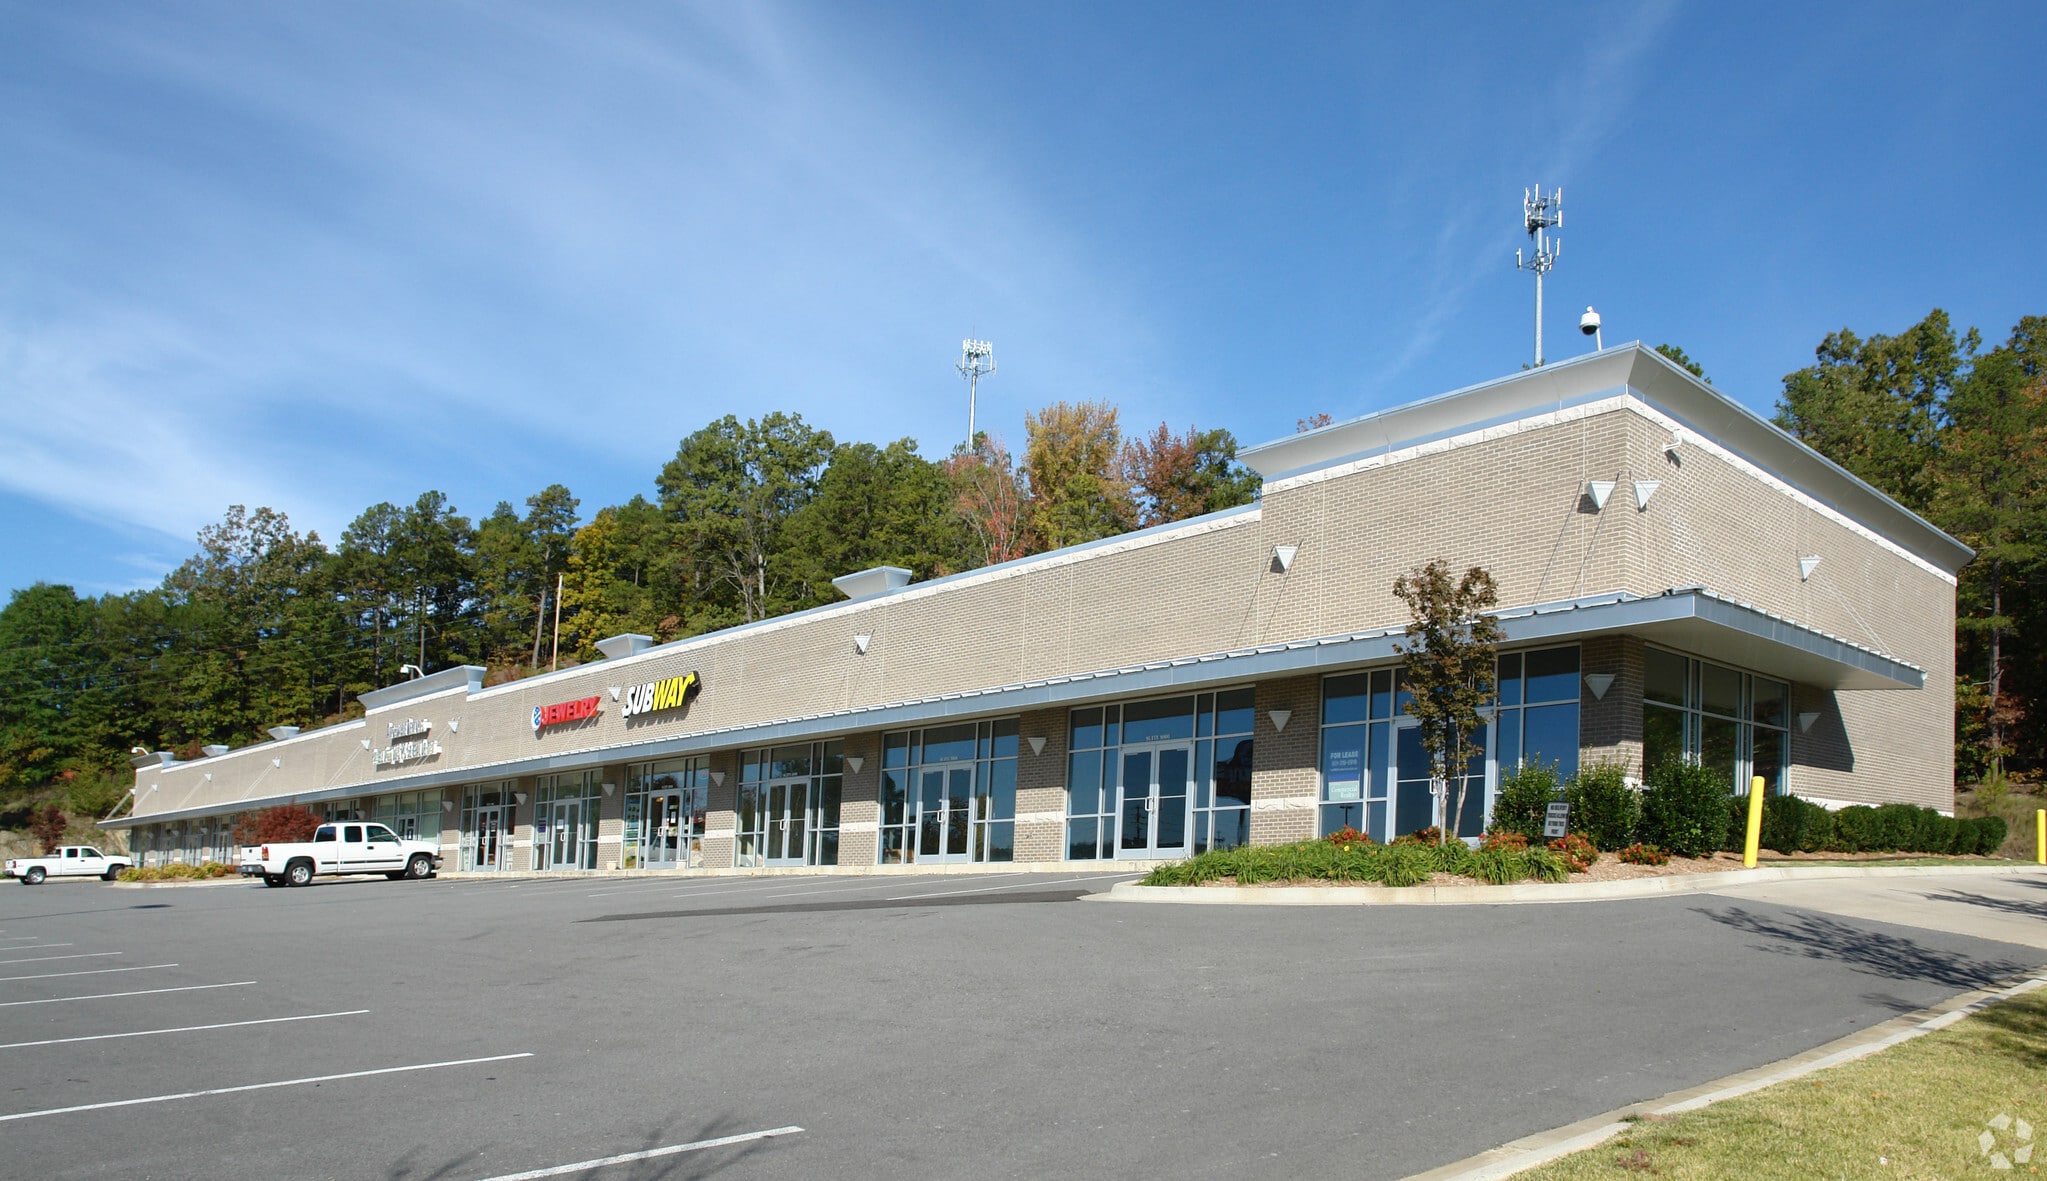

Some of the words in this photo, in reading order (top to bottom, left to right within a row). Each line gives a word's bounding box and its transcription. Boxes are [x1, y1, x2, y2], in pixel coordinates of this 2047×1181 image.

[621, 671, 697, 718] SUBWAY
[542, 696, 601, 725] JEWELRY
[1341, 751, 1359, 759] LEASE
